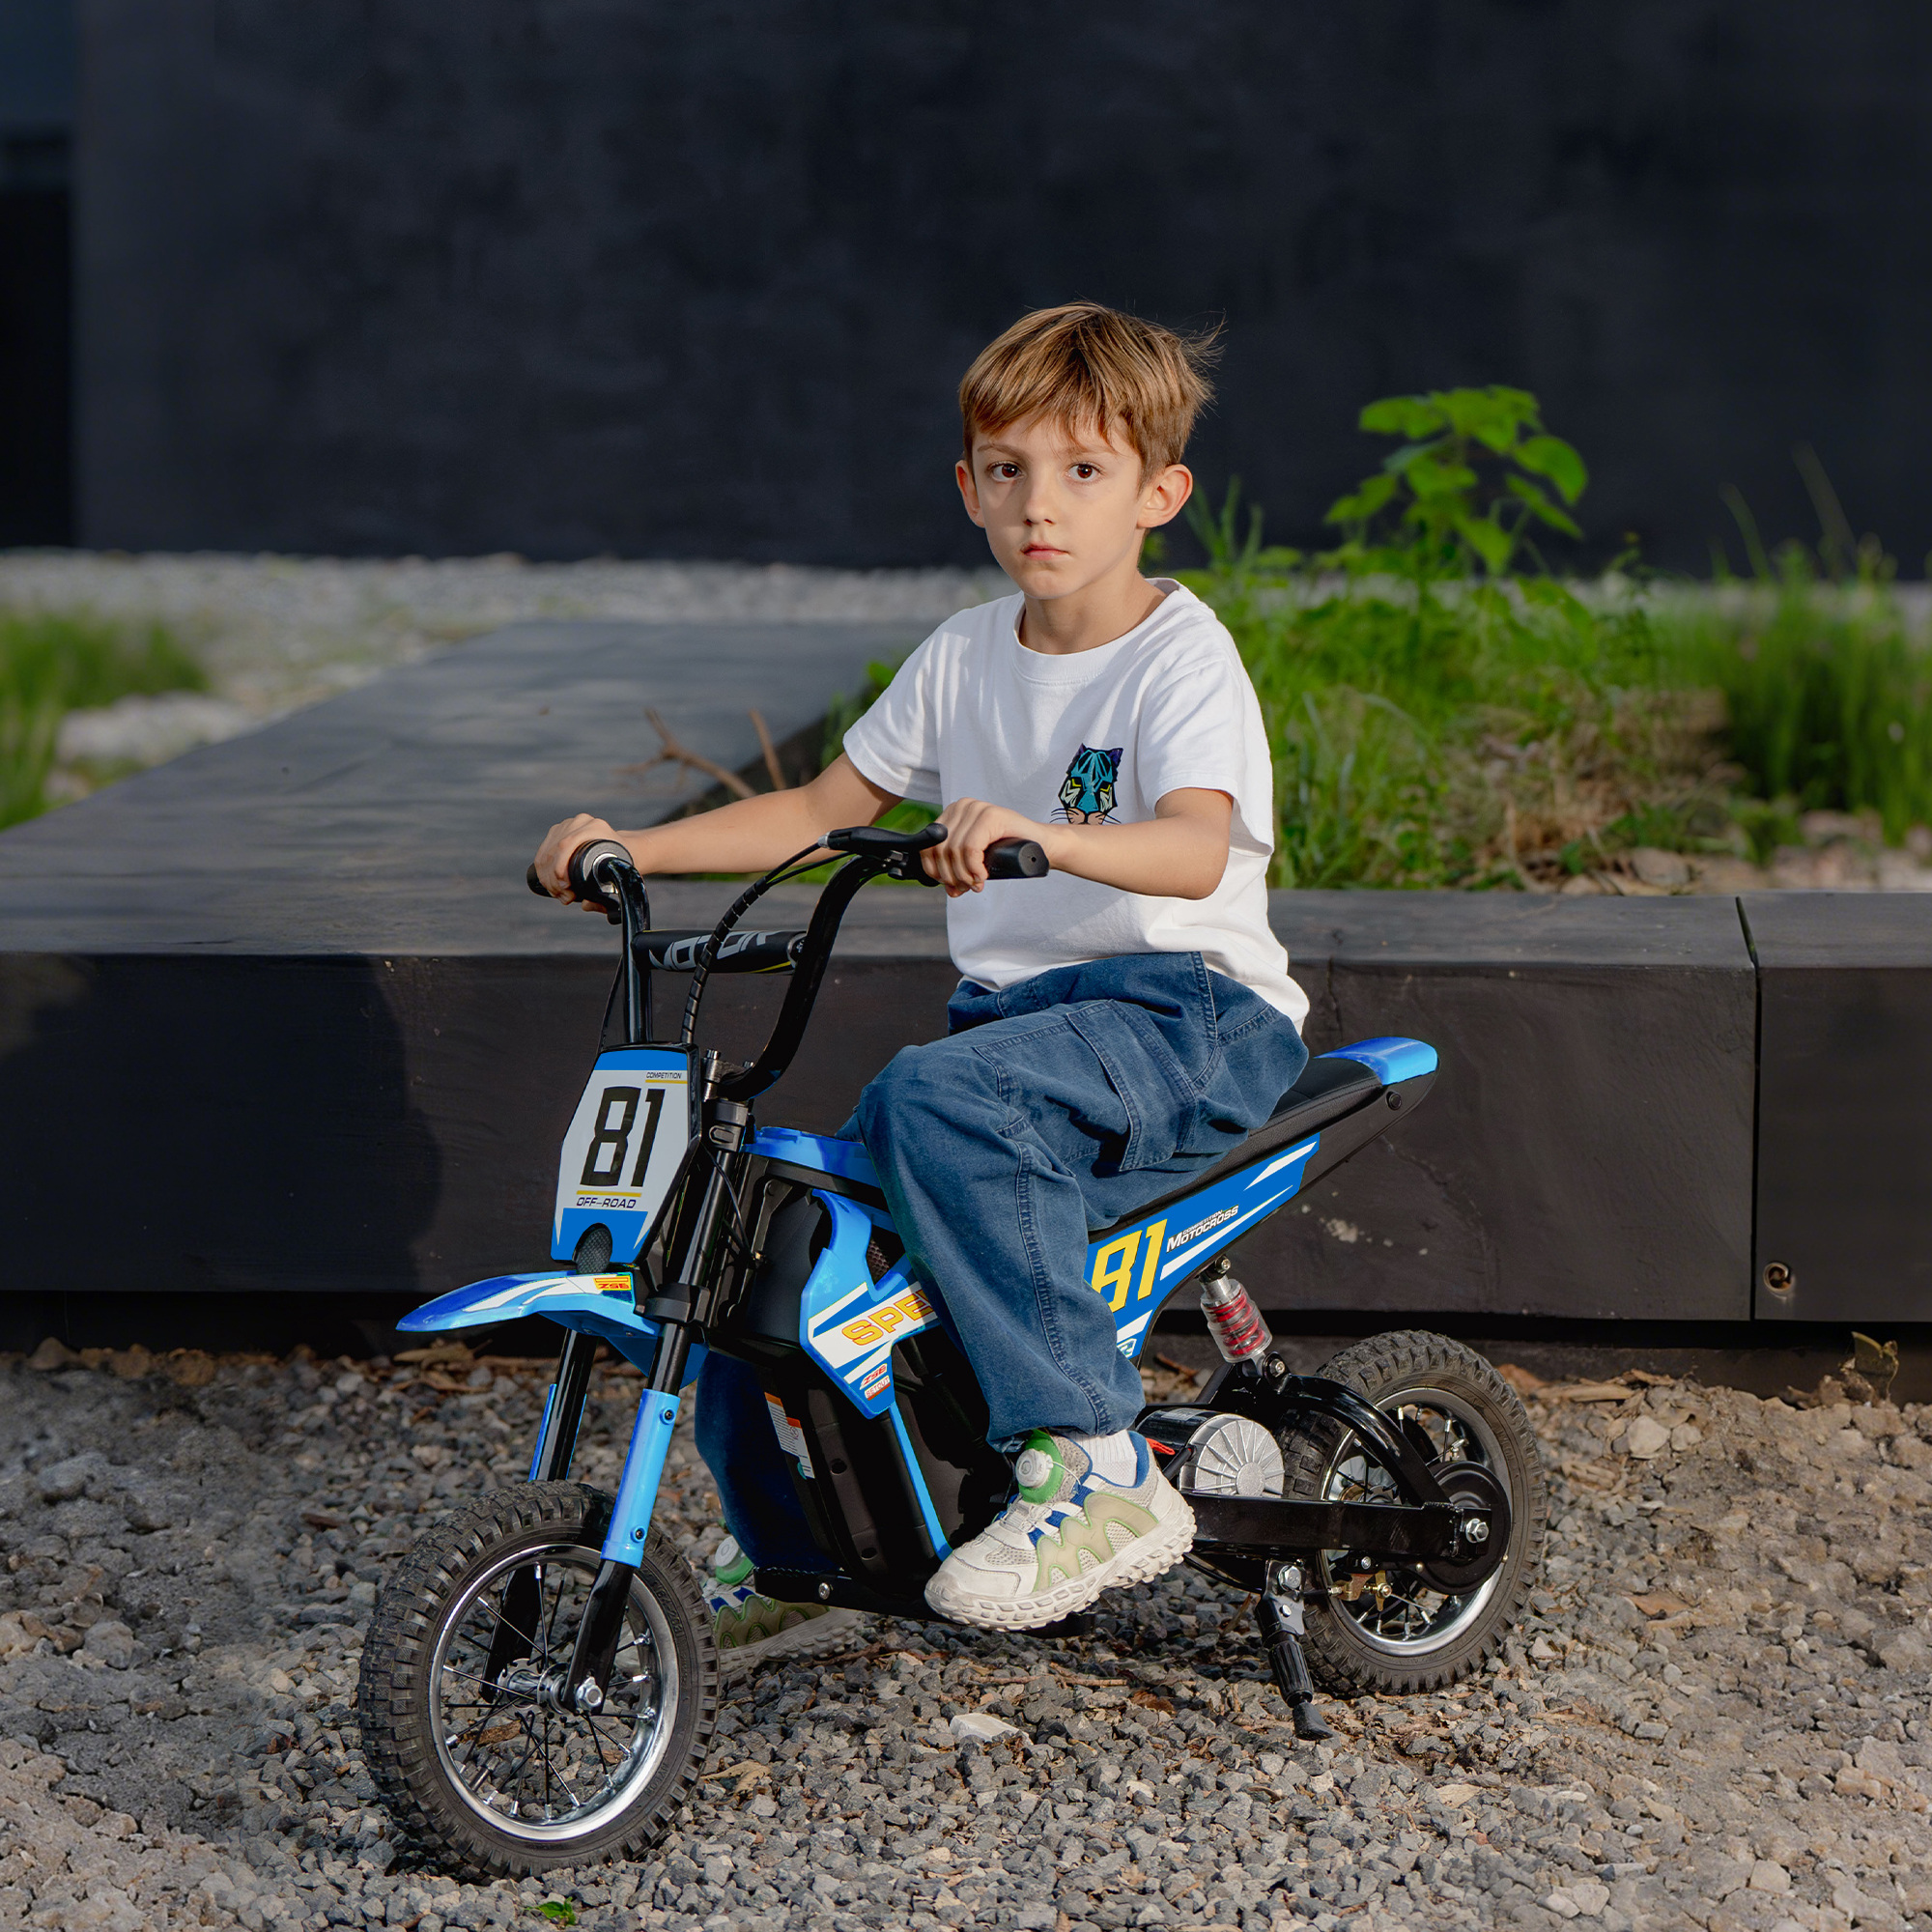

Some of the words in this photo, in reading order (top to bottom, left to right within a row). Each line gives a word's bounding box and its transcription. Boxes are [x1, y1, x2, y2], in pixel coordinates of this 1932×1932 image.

[580, 1086, 666, 1187] 81
[576, 1197, 637, 1208] OFF-ROAD
[1181, 1209, 1224, 1236] COMPETITION
[1166, 1205, 1238, 1253] MOTOCROSS
[1091, 1218, 1168, 1313] 81
[841, 1289, 934, 1346] SPE
